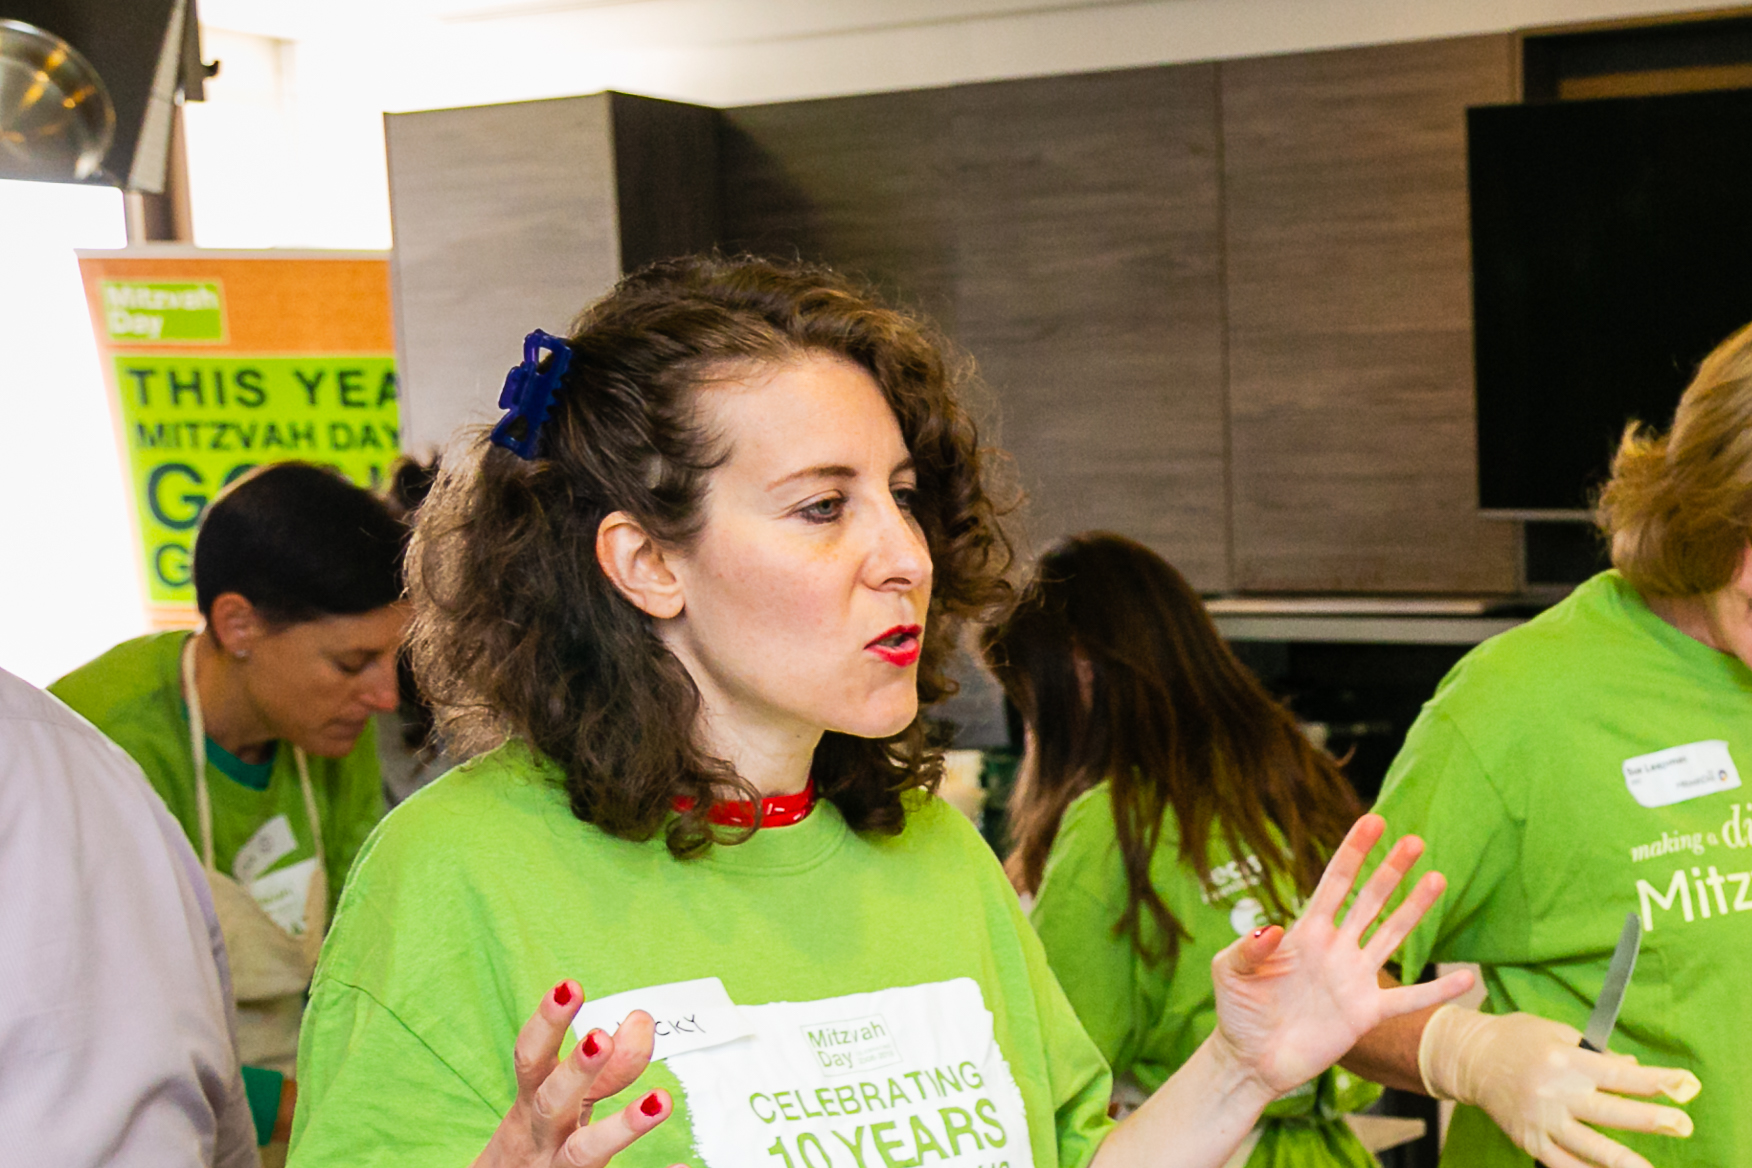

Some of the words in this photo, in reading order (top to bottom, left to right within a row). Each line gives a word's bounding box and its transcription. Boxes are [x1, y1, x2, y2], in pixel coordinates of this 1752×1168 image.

[105, 285, 219, 311] Mitzvah
[108, 311, 165, 339] Day
[127, 368, 268, 409] THIS
[135, 420, 316, 451] MITZVAH
[328, 419, 400, 451] DAY
[1631, 829, 1705, 863] making
[1707, 830, 1720, 846] a
[807, 1021, 886, 1048] Mitzvah
[817, 1051, 853, 1068] Day
[748, 1060, 983, 1125] CELEBRATING
